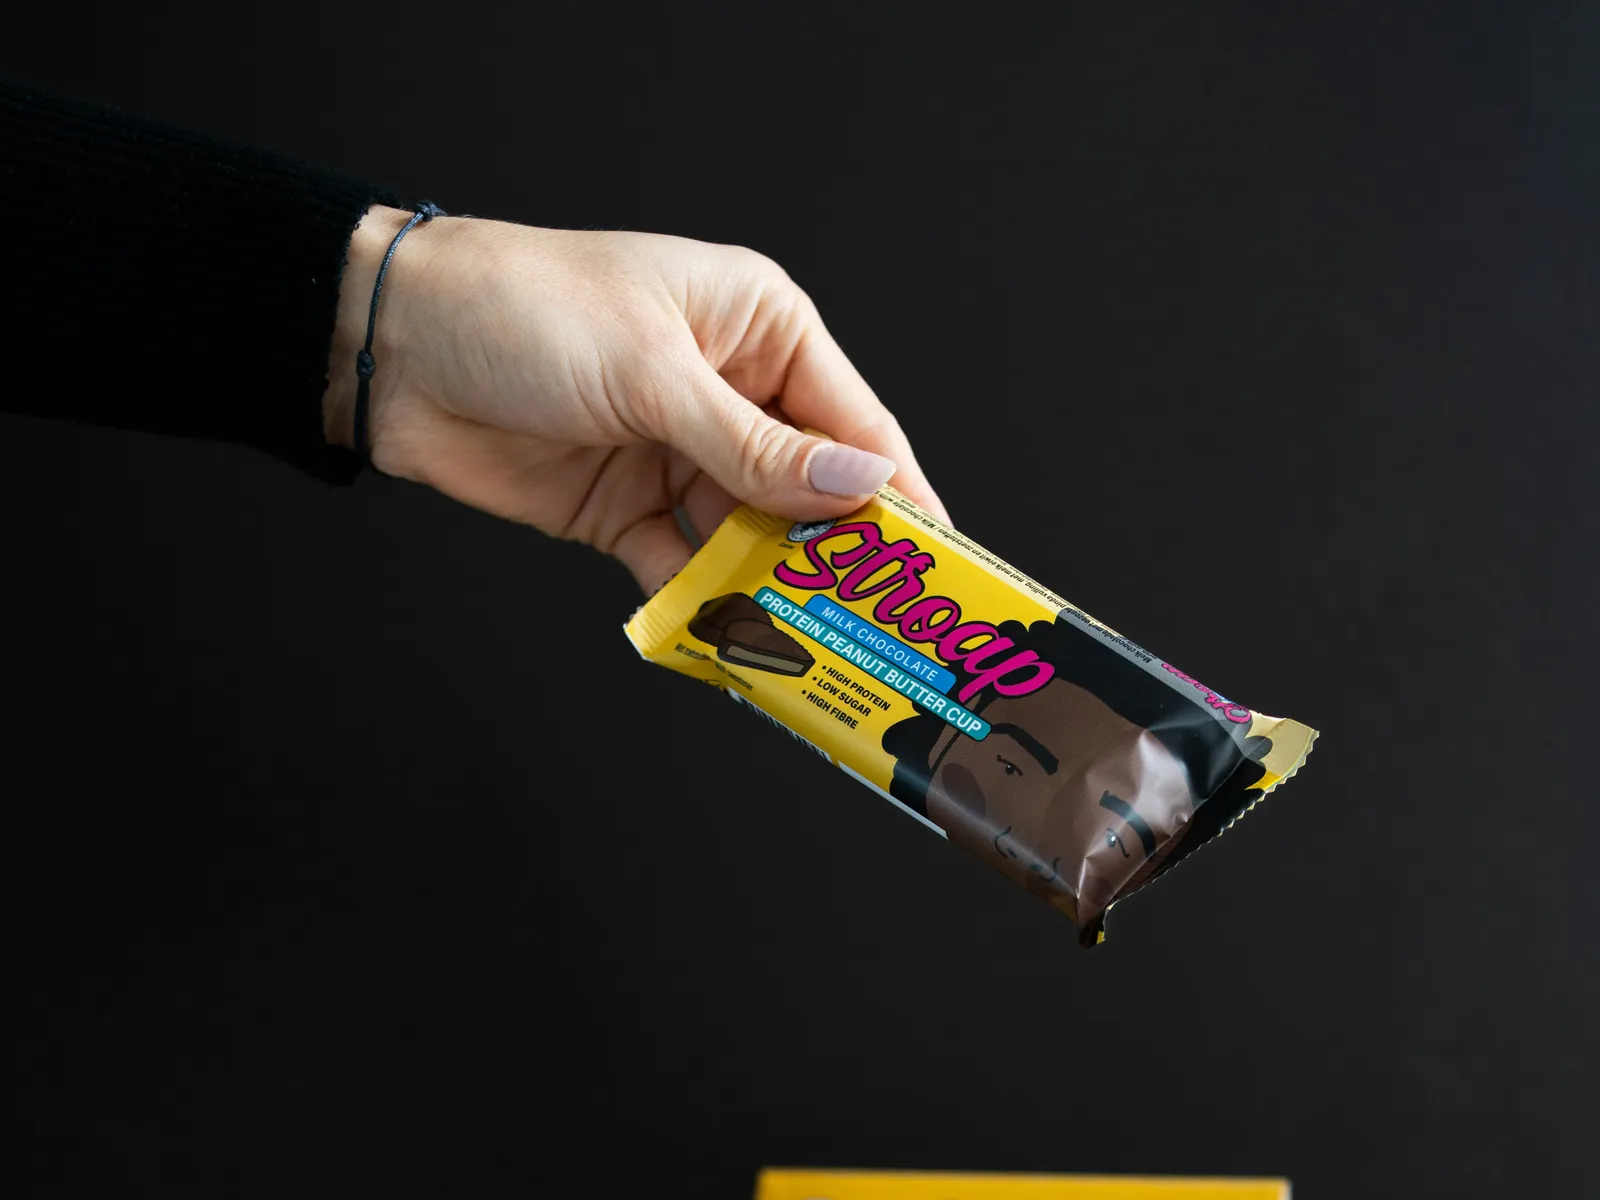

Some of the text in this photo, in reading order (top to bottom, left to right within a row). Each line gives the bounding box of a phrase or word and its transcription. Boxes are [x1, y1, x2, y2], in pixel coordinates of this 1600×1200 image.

[890, 500, 923, 521] chocolate
[920, 518, 936, 529] Milk
[970, 548, 981, 556] en
[994, 563, 1011, 576] melk
[1009, 572, 1024, 583] met
[773, 521, 1055, 703] Stroap
[1045, 594, 1066, 609] pinda
[821, 606, 939, 682] MILK CHOCOLATE
[760, 592, 982, 734] PROTEIN PEANUT BUTTER CUP
[816, 679, 872, 717] LOW SUGAR
[826, 667, 892, 712] HIGH PROTEIN
[806, 691, 859, 730] HIGH FIBRE
